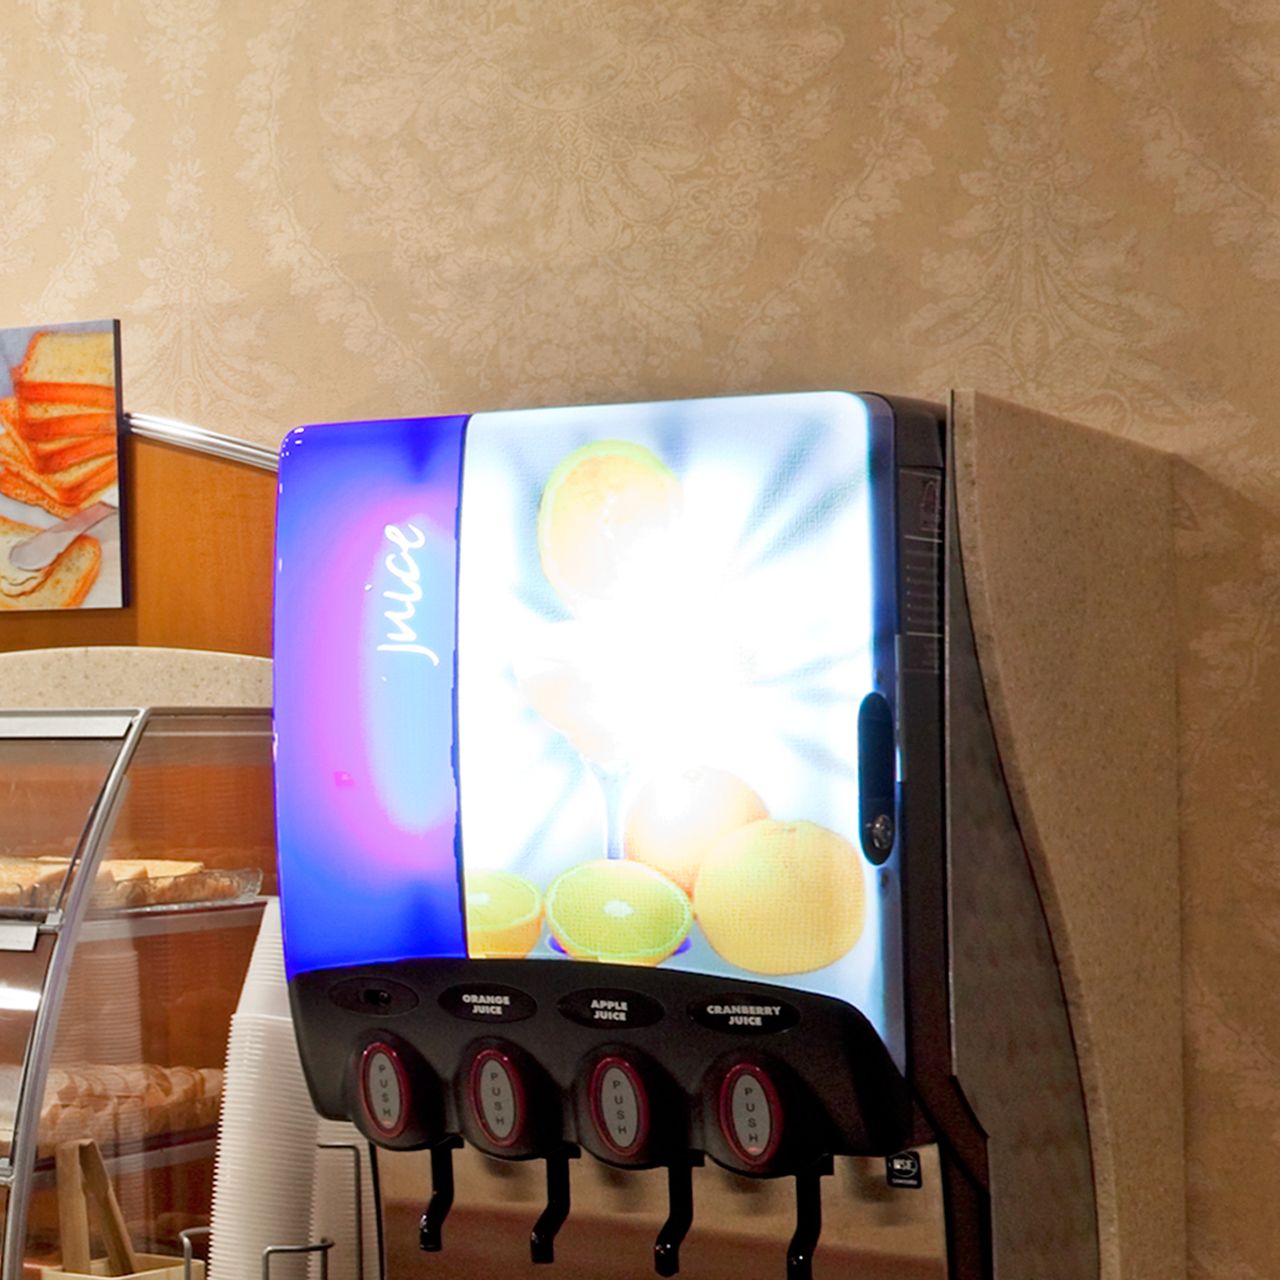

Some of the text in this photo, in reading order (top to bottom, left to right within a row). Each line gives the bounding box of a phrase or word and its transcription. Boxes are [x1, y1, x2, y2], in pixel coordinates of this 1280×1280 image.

[364, 523, 439, 681] juice
[462, 994, 510, 1005] ORANGE
[591, 999, 628, 1010] APPLE
[472, 1005, 503, 1015] JUICE
[593, 1010, 627, 1021] JUICE
[706, 1004, 782, 1016] CRANBERRY
[728, 1016, 762, 1026] JUICE
[378, 1064, 391, 1117] PUSH
[491, 1072, 505, 1126] PUSH
[612, 1079, 627, 1135] PUSH
[744, 1087, 759, 1144] PUSH
